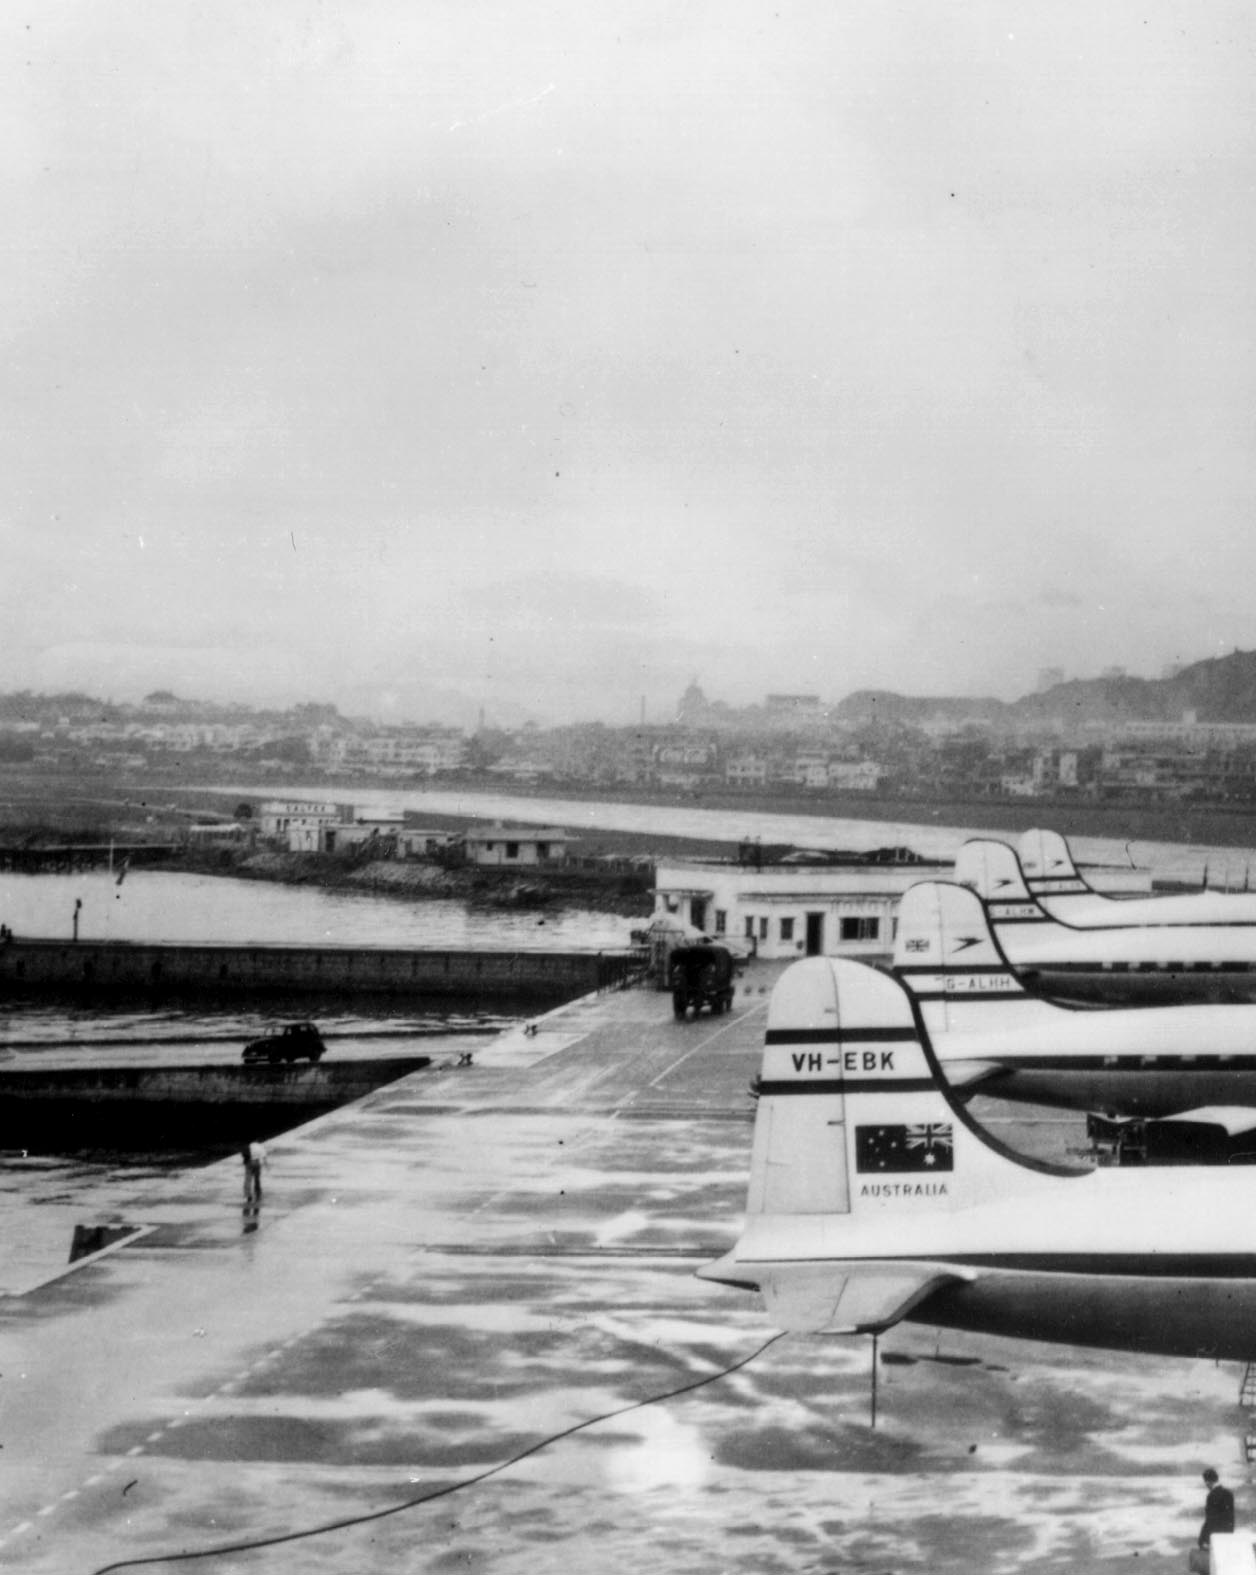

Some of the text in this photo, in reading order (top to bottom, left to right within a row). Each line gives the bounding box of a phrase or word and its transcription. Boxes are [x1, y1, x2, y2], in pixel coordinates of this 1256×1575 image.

[946, 977, 1010, 990] G-ALHH
[792, 1050, 895, 1073] VH-EBK
[860, 1183, 949, 1198] AUSTRALIA
